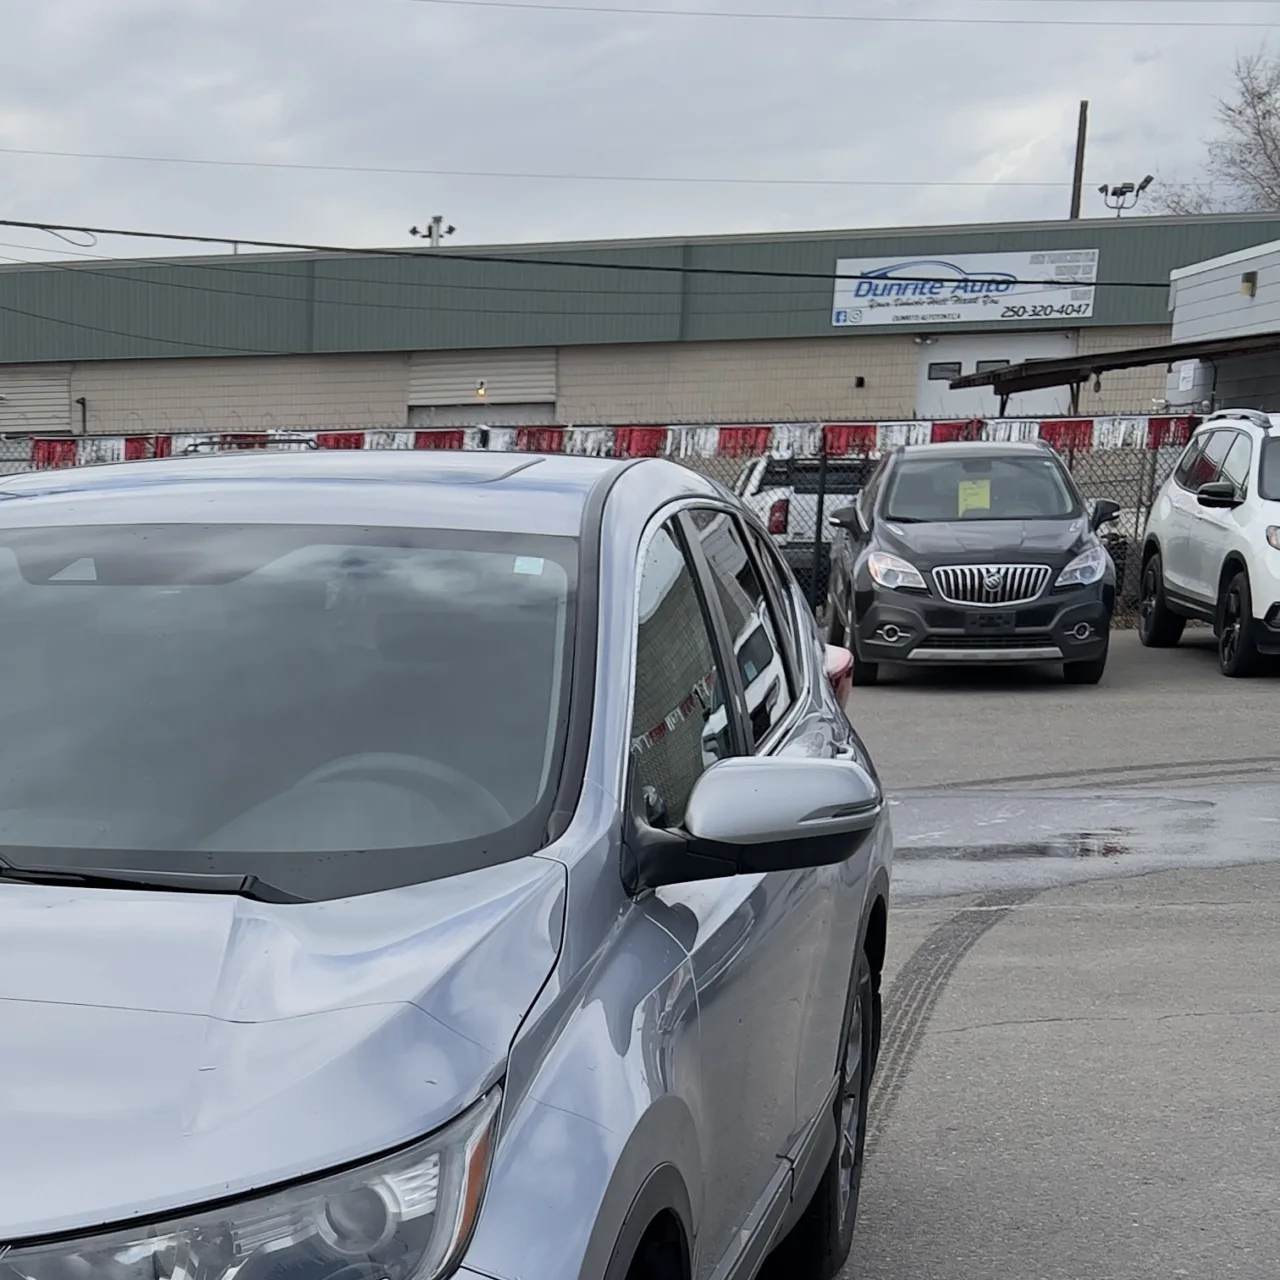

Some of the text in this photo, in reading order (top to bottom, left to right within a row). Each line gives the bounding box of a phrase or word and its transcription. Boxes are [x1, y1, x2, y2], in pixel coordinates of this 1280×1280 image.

[854, 277, 1010, 298] Dunrite Auto
[1001, 302, 1090, 318] 250-320-4047
